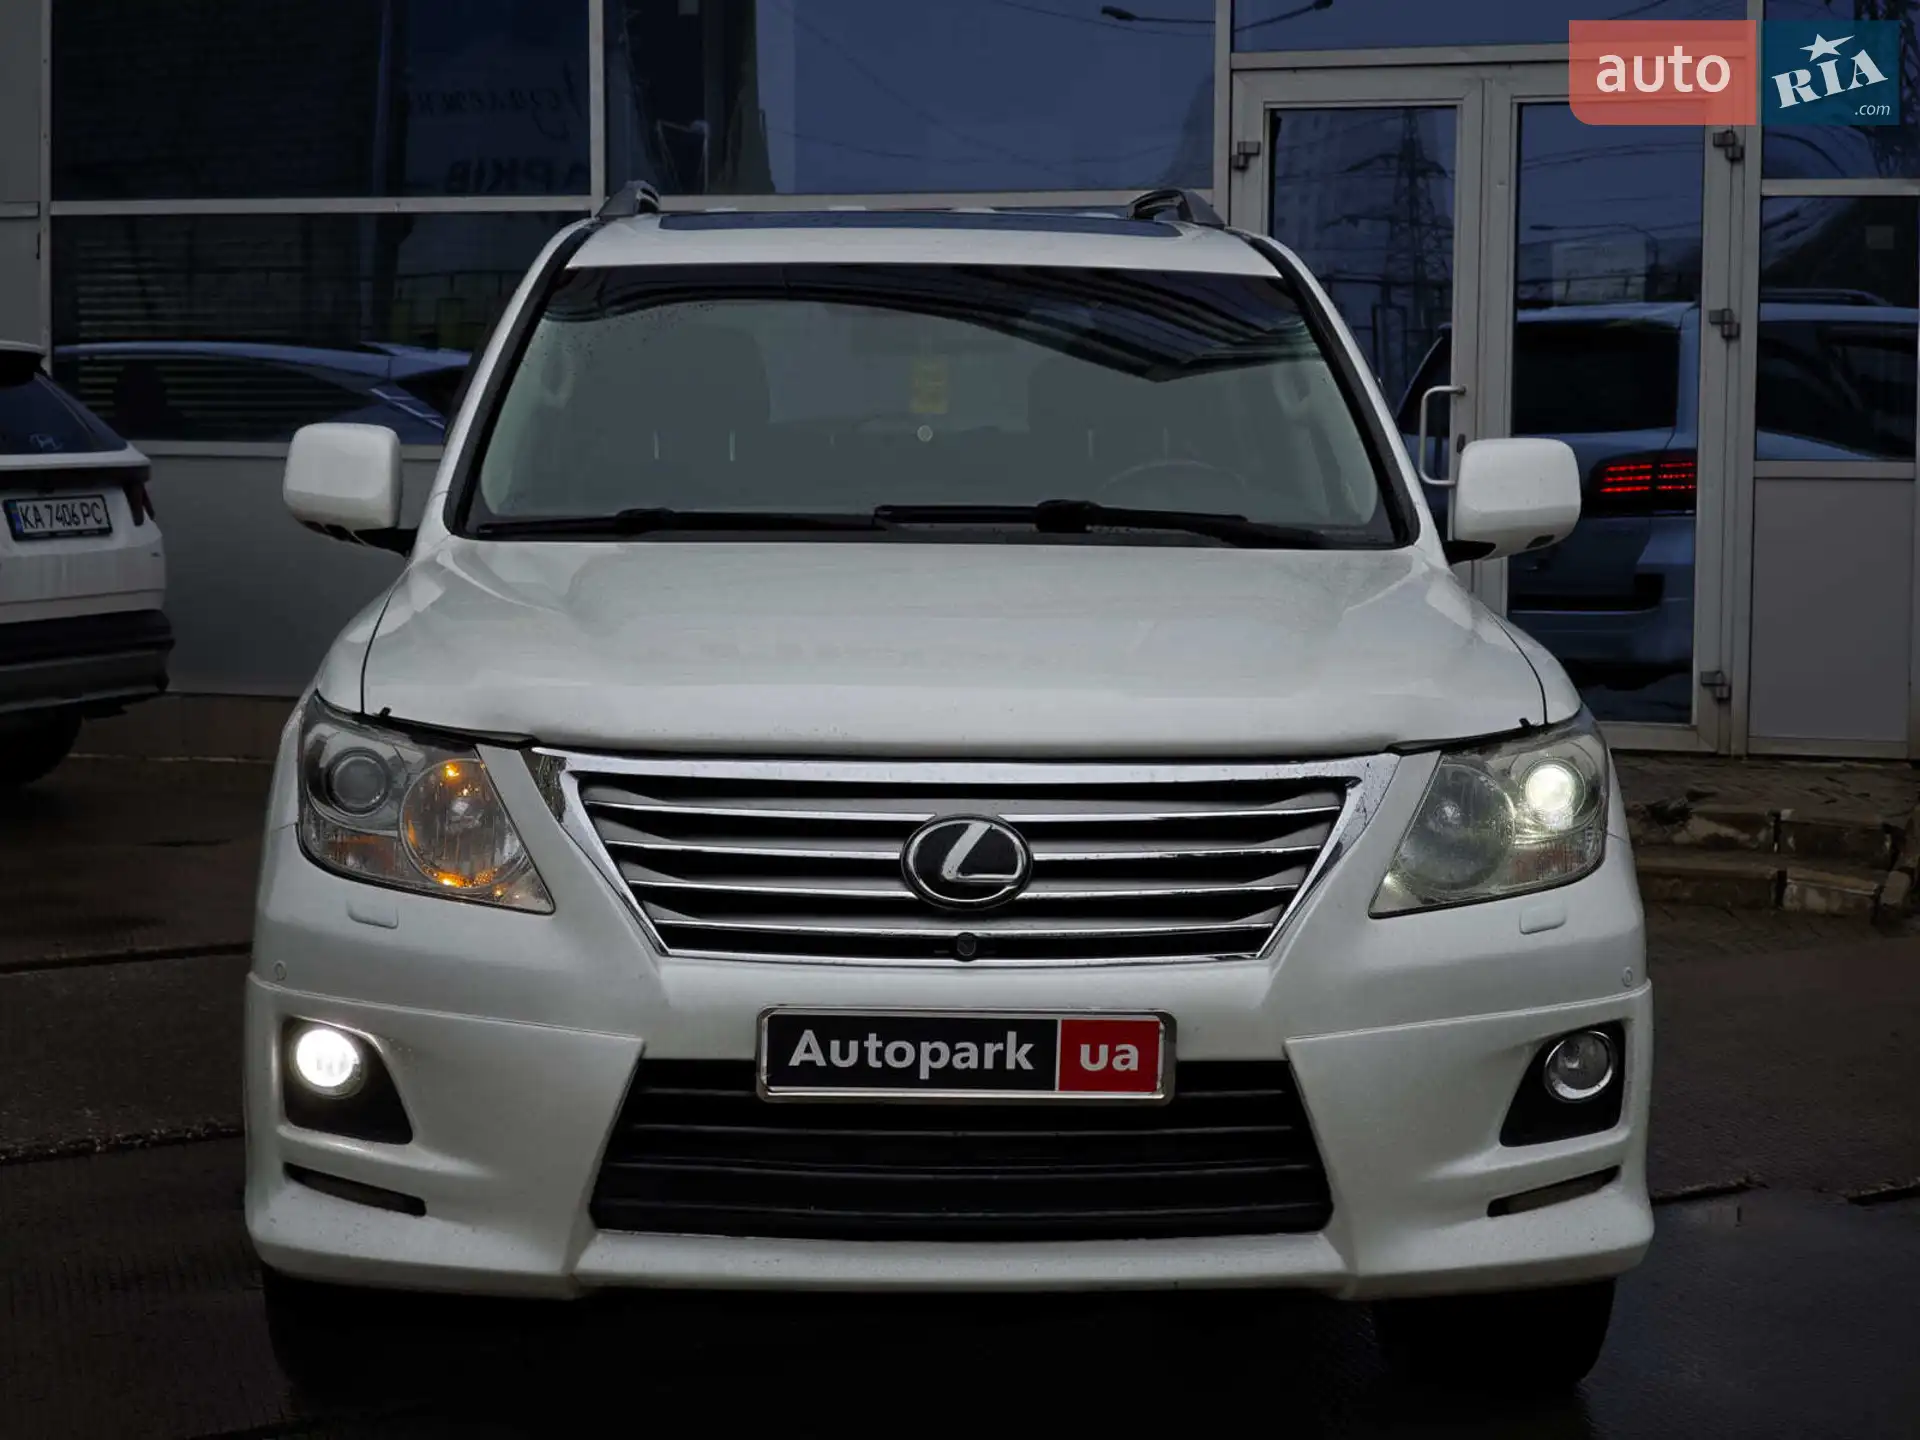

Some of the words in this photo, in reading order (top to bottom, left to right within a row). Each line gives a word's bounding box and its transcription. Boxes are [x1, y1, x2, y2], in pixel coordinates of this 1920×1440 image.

[20, 505, 44, 529] KA
[80, 502, 102, 525] PC
[788, 1028, 1035, 1080] Autopark
[1079, 1042, 1139, 1072] ua
